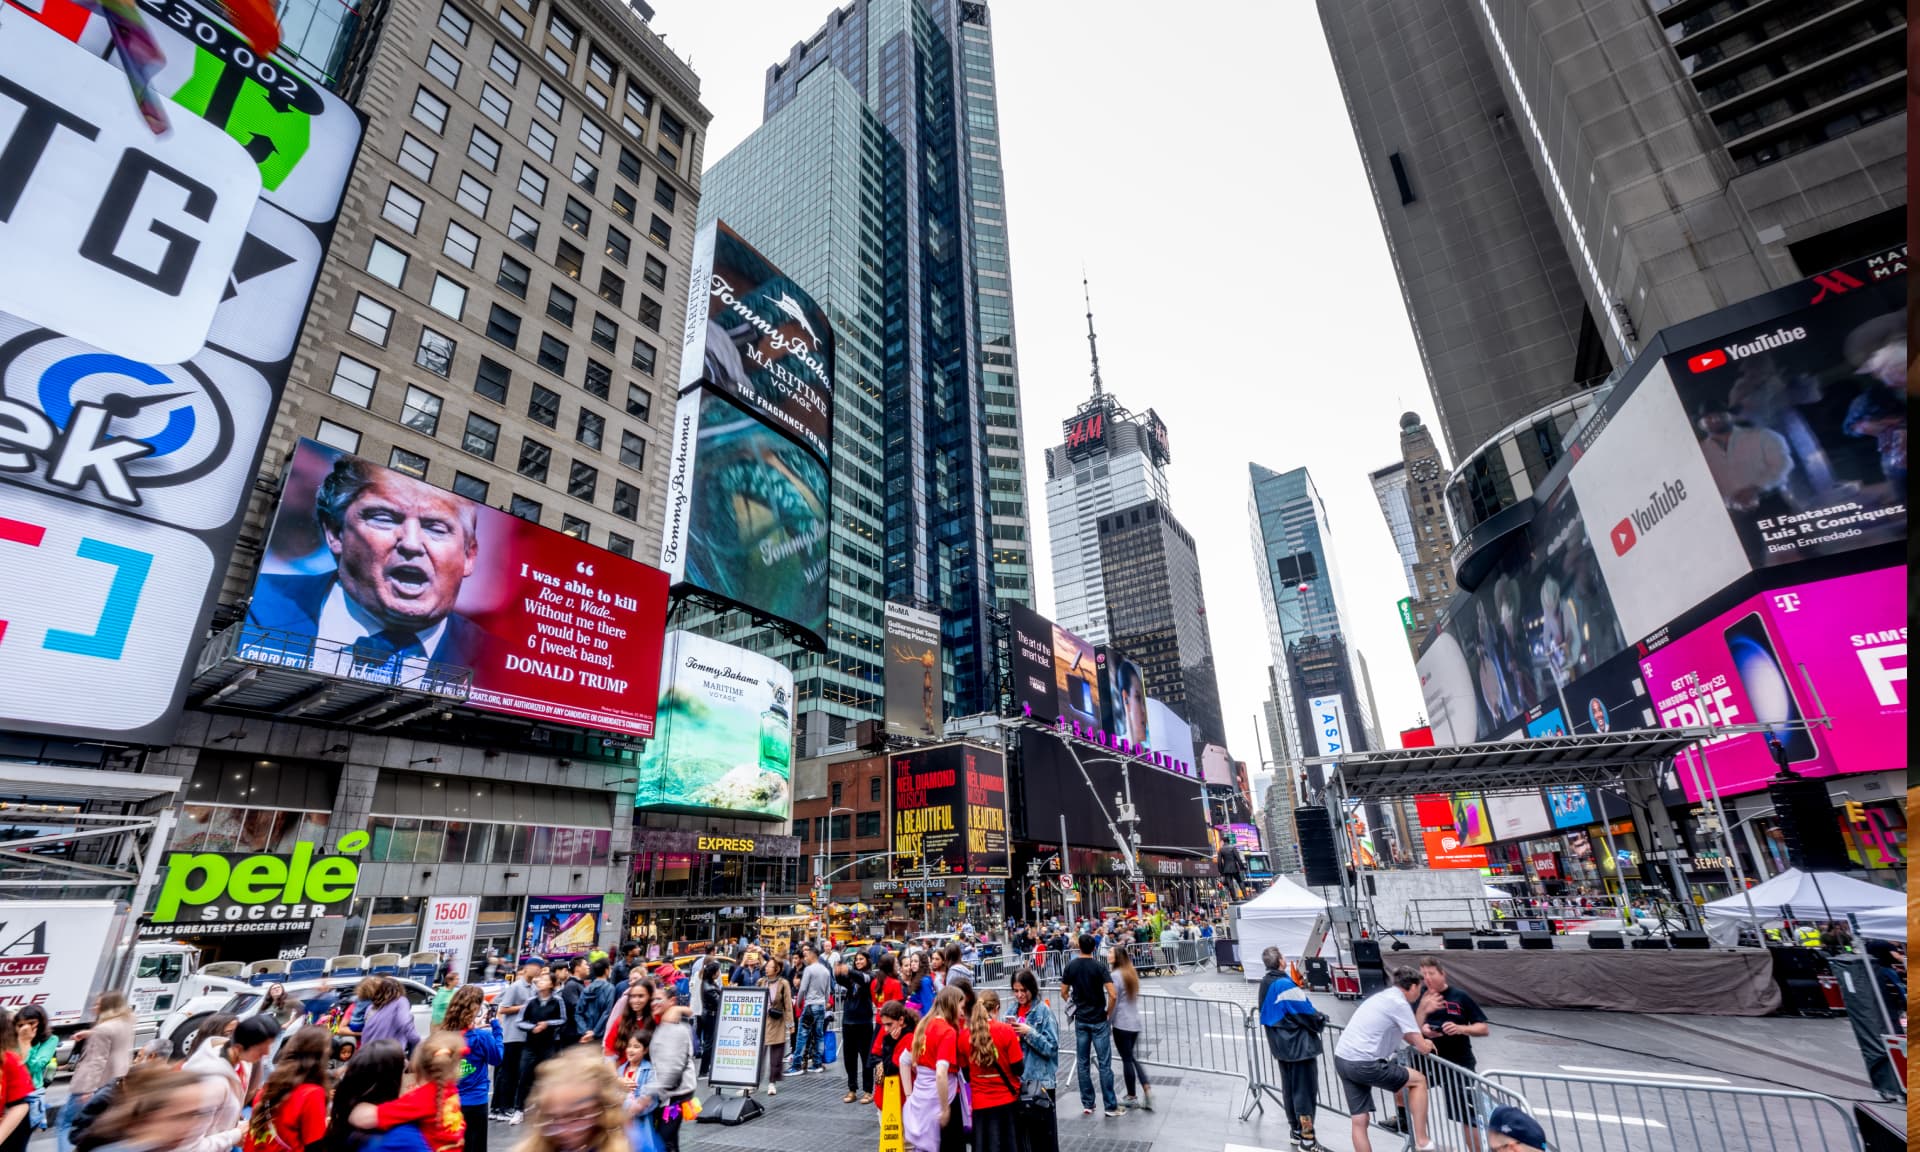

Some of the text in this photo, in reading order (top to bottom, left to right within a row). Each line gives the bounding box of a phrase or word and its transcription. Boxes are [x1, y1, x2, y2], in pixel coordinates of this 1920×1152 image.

[685, 264, 702, 346] MARITIME
[1725, 326, 1807, 361] YouTube
[747, 343, 827, 418] MARITIME
[770, 377, 812, 412] VOYAGE
[737, 383, 754, 400] THE
[757, 396, 803, 433] FRAGRANCE
[805, 427, 818, 444] FOR
[1067, 413, 1103, 448] H&M
[1631, 478, 1688, 537] YouTube
[1757, 501, 1863, 530] El Fantasma,
[1762, 504, 1907, 542] Luis R Conriquez
[1768, 543, 1796, 553] Bien
[520, 563, 637, 612] I was able to kill
[539, 587, 616, 621] Roe v. Wade...
[888, 604, 909, 617] MoMA
[525, 598, 627, 639] Without me there
[537, 622, 608, 650] would be no
[911, 632, 938, 645] Pinocchio
[1017, 630, 1028, 645] The
[1037, 642, 1042, 651] of
[1042, 644, 1050, 656] the
[1646, 627, 1669, 644] MARRIOTT
[1648, 636, 1669, 651] MARQUIS
[269, 653, 283, 665] FO
[528, 634, 615, 670] 6 [week bans].
[1022, 648, 1037, 661] smart
[505, 655, 628, 694] DONALD TRUMP
[1671, 675, 1687, 691] GET
[703, 680, 745, 697] MARITIME
[709, 691, 737, 702] VOYAGE
[503, 695, 513, 706] NOT
[514, 698, 545, 713] AUTHORIZED
[553, 706, 564, 715] ANY
[564, 709, 590, 721] CANDIDATE
[1658, 691, 1689, 711] SAMSUNG
[897, 760, 911, 776] THE
[966, 754, 976, 771] THE
[897, 769, 956, 792] NEIL DIAMOND
[966, 771, 1004, 792] NEIL DIAMOND
[897, 790, 928, 809] MUSICAL
[897, 805, 955, 834] A BEAUTIFUL
[968, 805, 1005, 830] A BEAUTIFUL
[697, 836, 754, 852] EXPRESS
[897, 833, 924, 858] NOISE
[968, 829, 987, 853] NOISE
[1158, 860, 1176, 874] FOREVER
[1694, 856, 1735, 869] SEPHR
[152, 830, 370, 923] pelé
[873, 881, 898, 890] GIFTS
[201, 904, 326, 921] SOCCER
[435, 902, 467, 920] 1560
[138, 921, 312, 935] RLD'S GREATEST SOCCER STORE
[0, 921, 51, 956] A
[279, 945, 307, 958] pelé
[724, 995, 763, 1003] CELEBRATE
[723, 1003, 762, 1016] PRIDE
[717, 1048, 756, 1056] DISCOUNTS
[722, 1057, 755, 1066] FREEBIES
